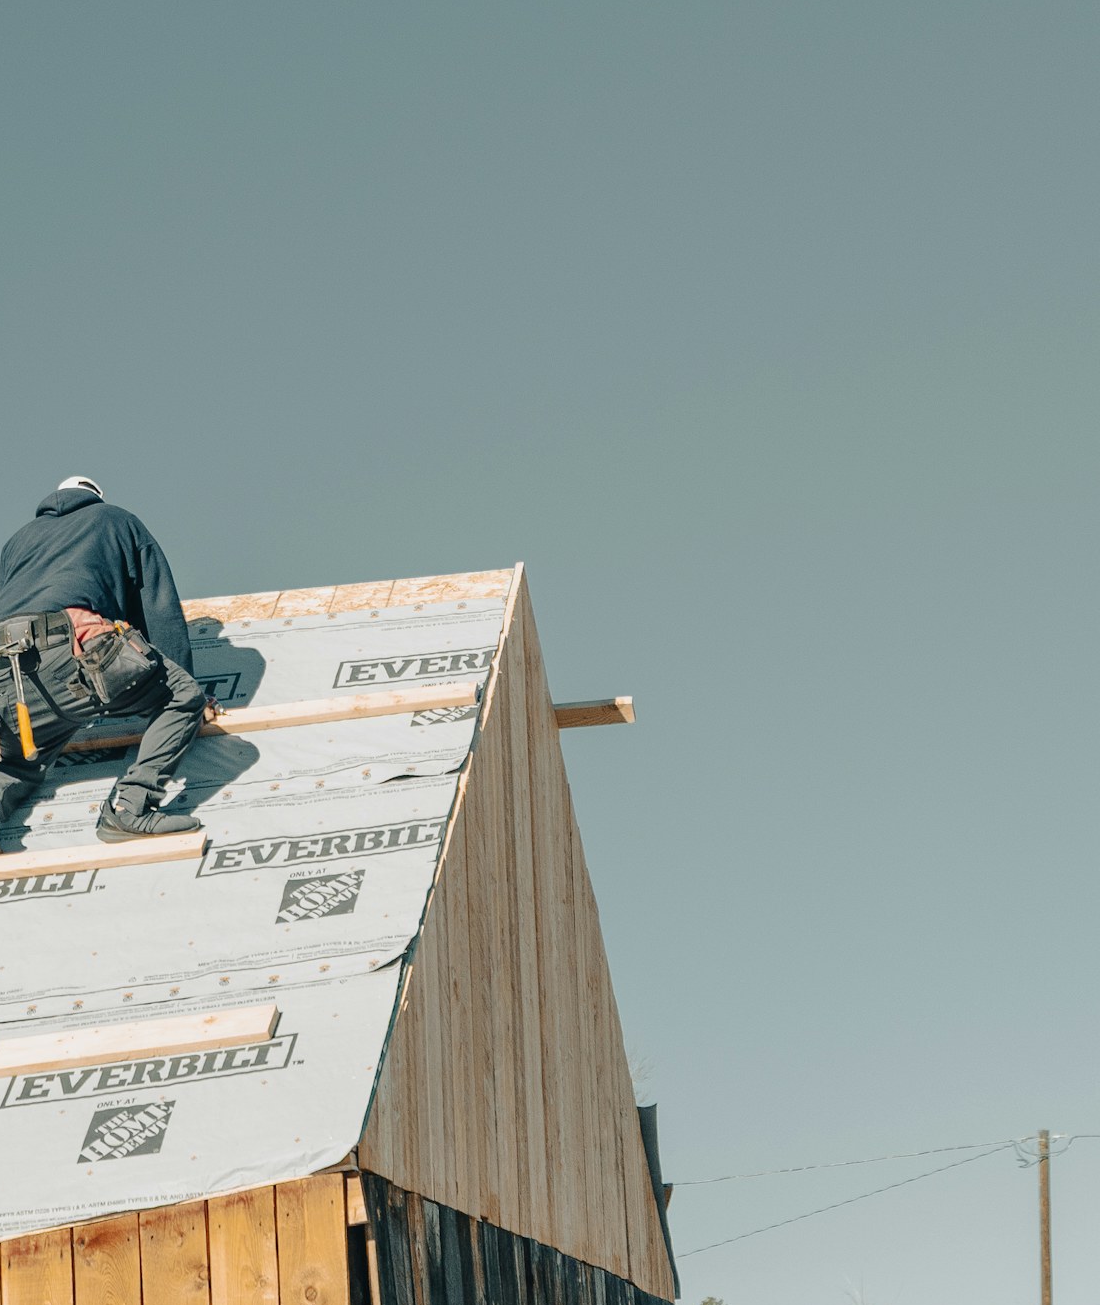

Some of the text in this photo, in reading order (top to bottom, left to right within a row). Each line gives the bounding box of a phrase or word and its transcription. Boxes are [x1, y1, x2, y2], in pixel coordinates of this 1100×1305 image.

[289, 870, 313, 879] ONLY
[290, 879, 326, 900] THE
[278, 871, 364, 923] HOME
[308, 885, 360, 920] DEPOT
[15, 1041, 283, 1102] EVERBILT
[96, 1097, 136, 1109] ONLY AT
[81, 1102, 174, 1162] HOME
[95, 1110, 133, 1135] THE
[110, 1118, 168, 1159] DEPOT
